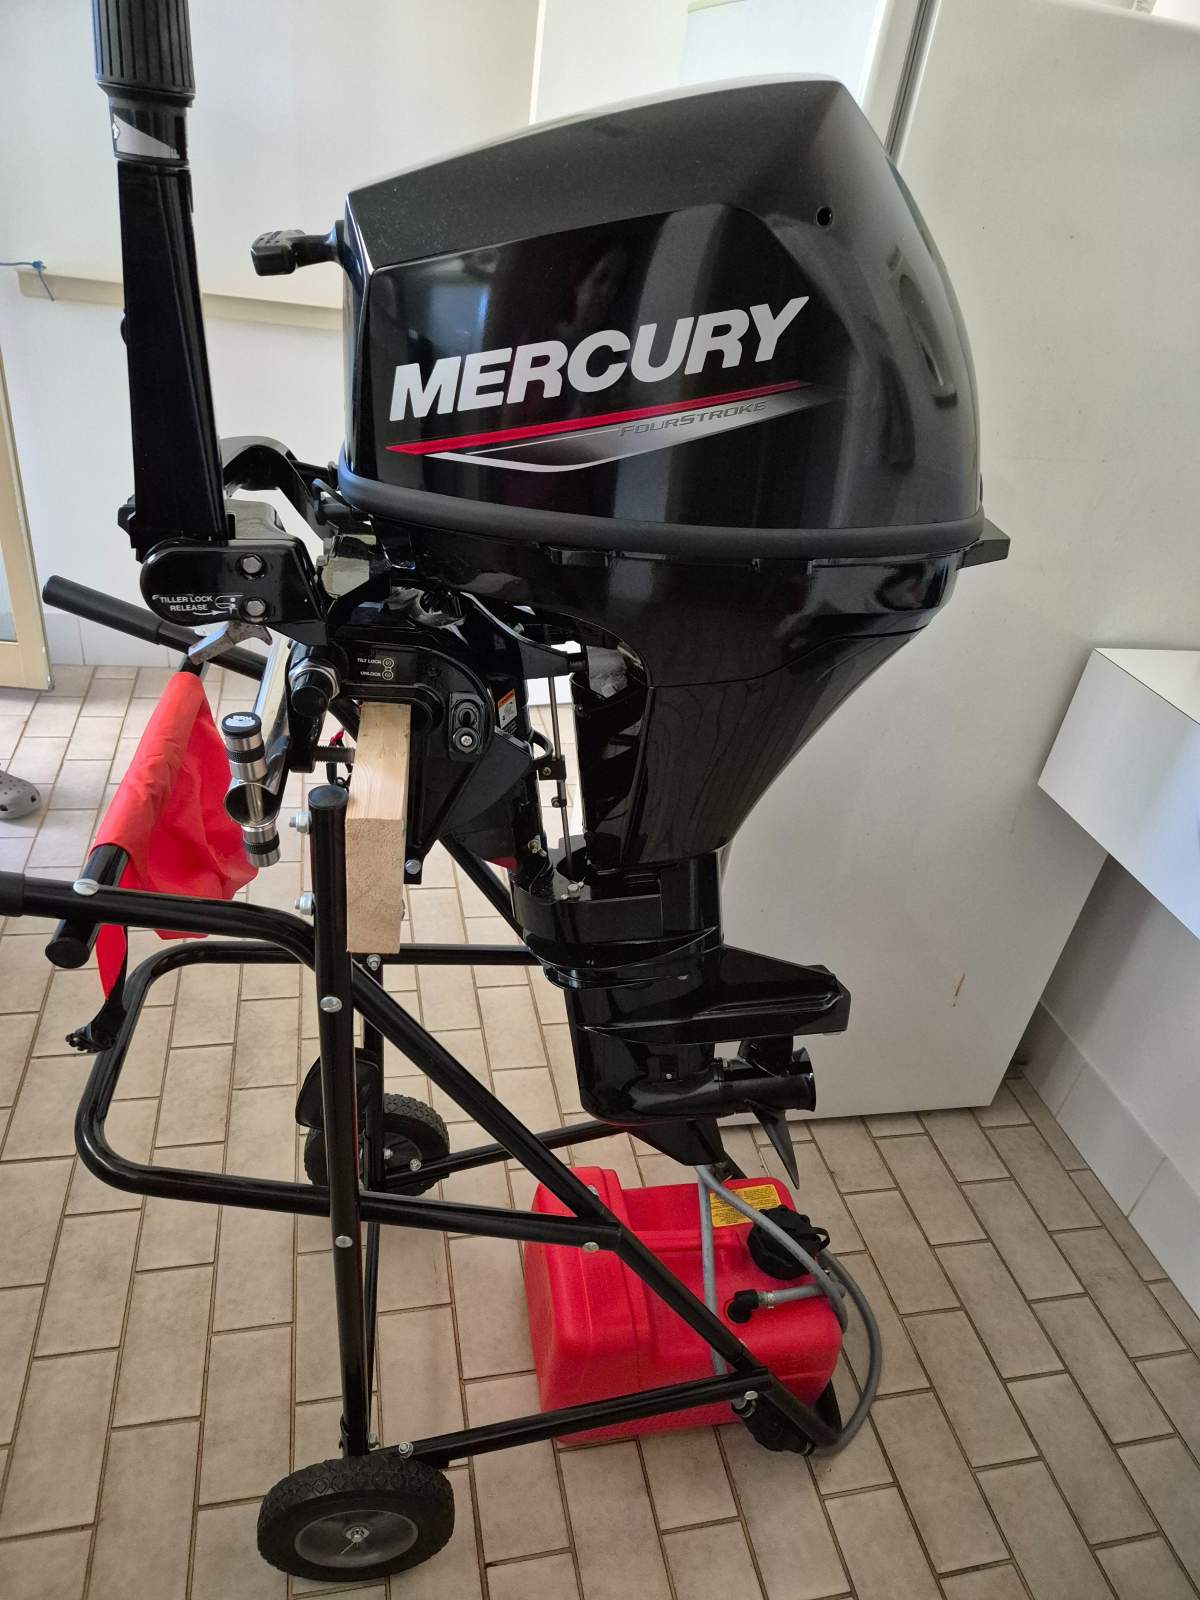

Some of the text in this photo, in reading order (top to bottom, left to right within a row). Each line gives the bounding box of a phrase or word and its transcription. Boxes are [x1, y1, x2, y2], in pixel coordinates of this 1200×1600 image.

[389, 295, 810, 422] MERCURY
[619, 401, 767, 437] FOURSTROKE
[190, 595, 213, 603] LOCK
